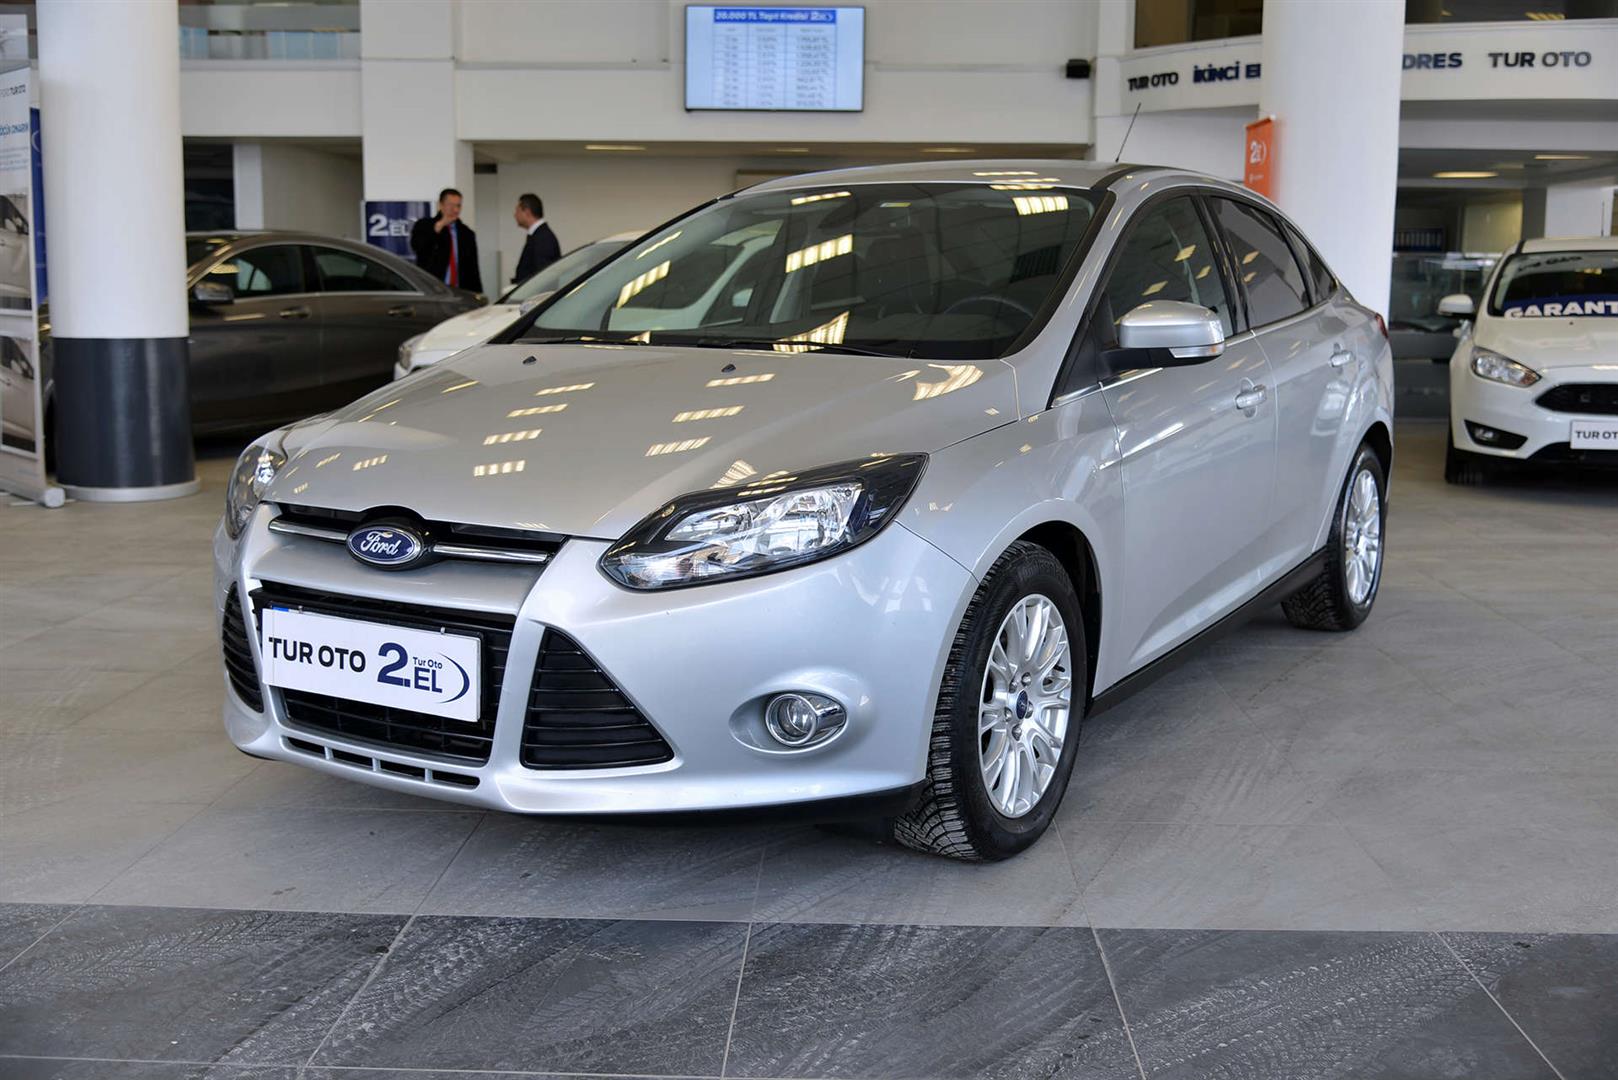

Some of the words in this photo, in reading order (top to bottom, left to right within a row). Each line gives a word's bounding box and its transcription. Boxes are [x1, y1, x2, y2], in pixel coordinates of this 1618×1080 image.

[1488, 52, 1535, 68] TUR
[1542, 51, 1592, 68] OTO
[1128, 75, 1149, 91] TUR
[1151, 72, 1179, 87] OTO
[1575, 431, 1600, 440] TUR
[361, 531, 401, 556] Ford
[268, 636, 313, 664] TUR
[318, 645, 366, 673] OTO
[412, 656, 427, 667] Tur
[427, 658, 443, 670] Oto
